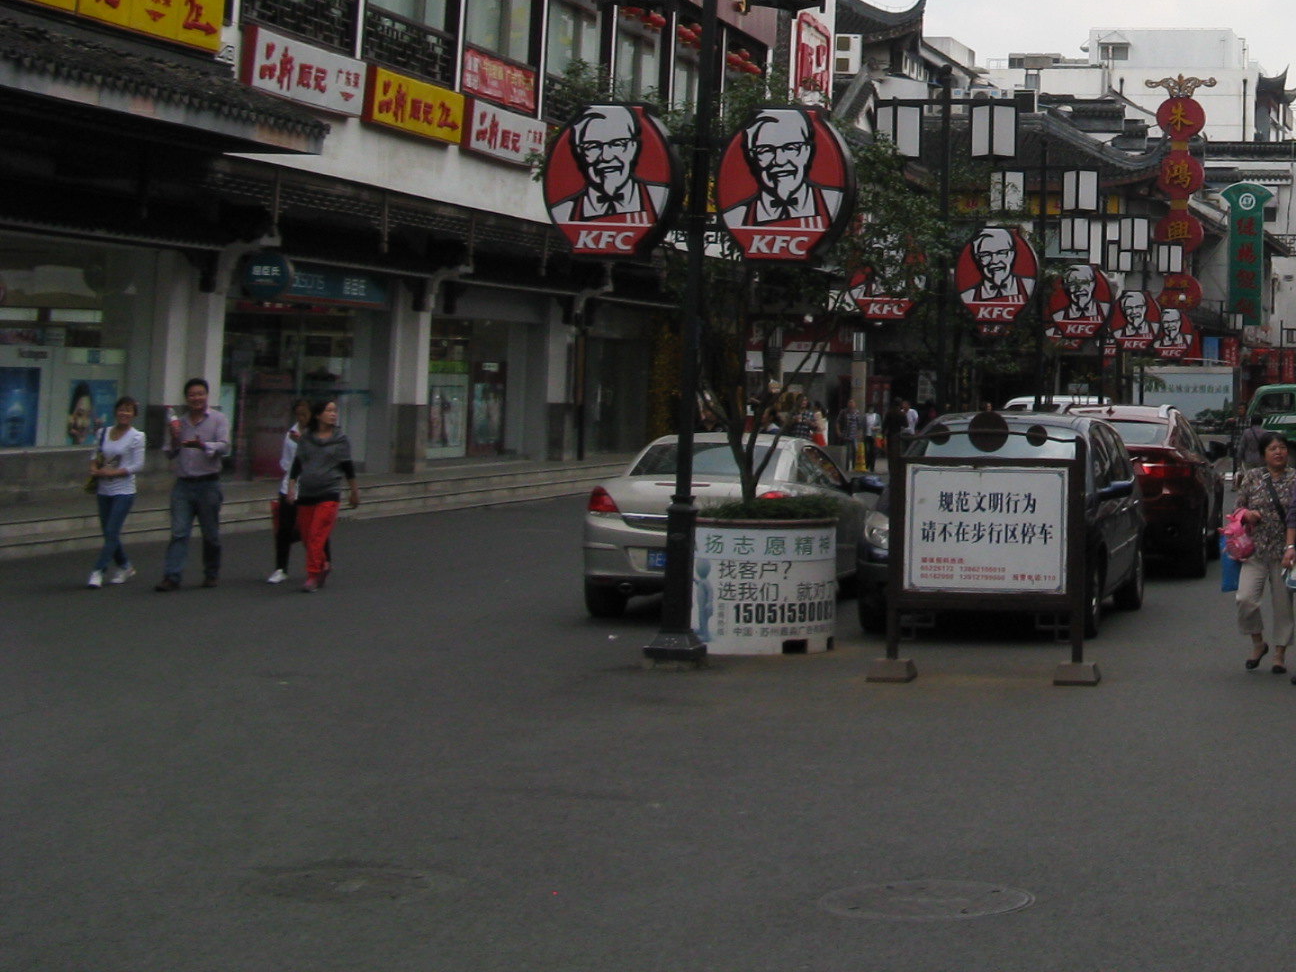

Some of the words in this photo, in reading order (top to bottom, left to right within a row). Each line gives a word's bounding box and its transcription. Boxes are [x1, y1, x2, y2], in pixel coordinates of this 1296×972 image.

[575, 230, 634, 250] KFC
[748, 235, 811, 256] KFC
[867, 302, 905, 316] KFC
[977, 305, 1015, 320] KFC
[1065, 324, 1095, 335] KFC
[1123, 339, 1147, 350] KFC
[1161, 347, 1184, 358] KFC
[938, 491, 1037, 515] 规范文明行为
[921, 521, 1053, 545] 请不在步行区停车
